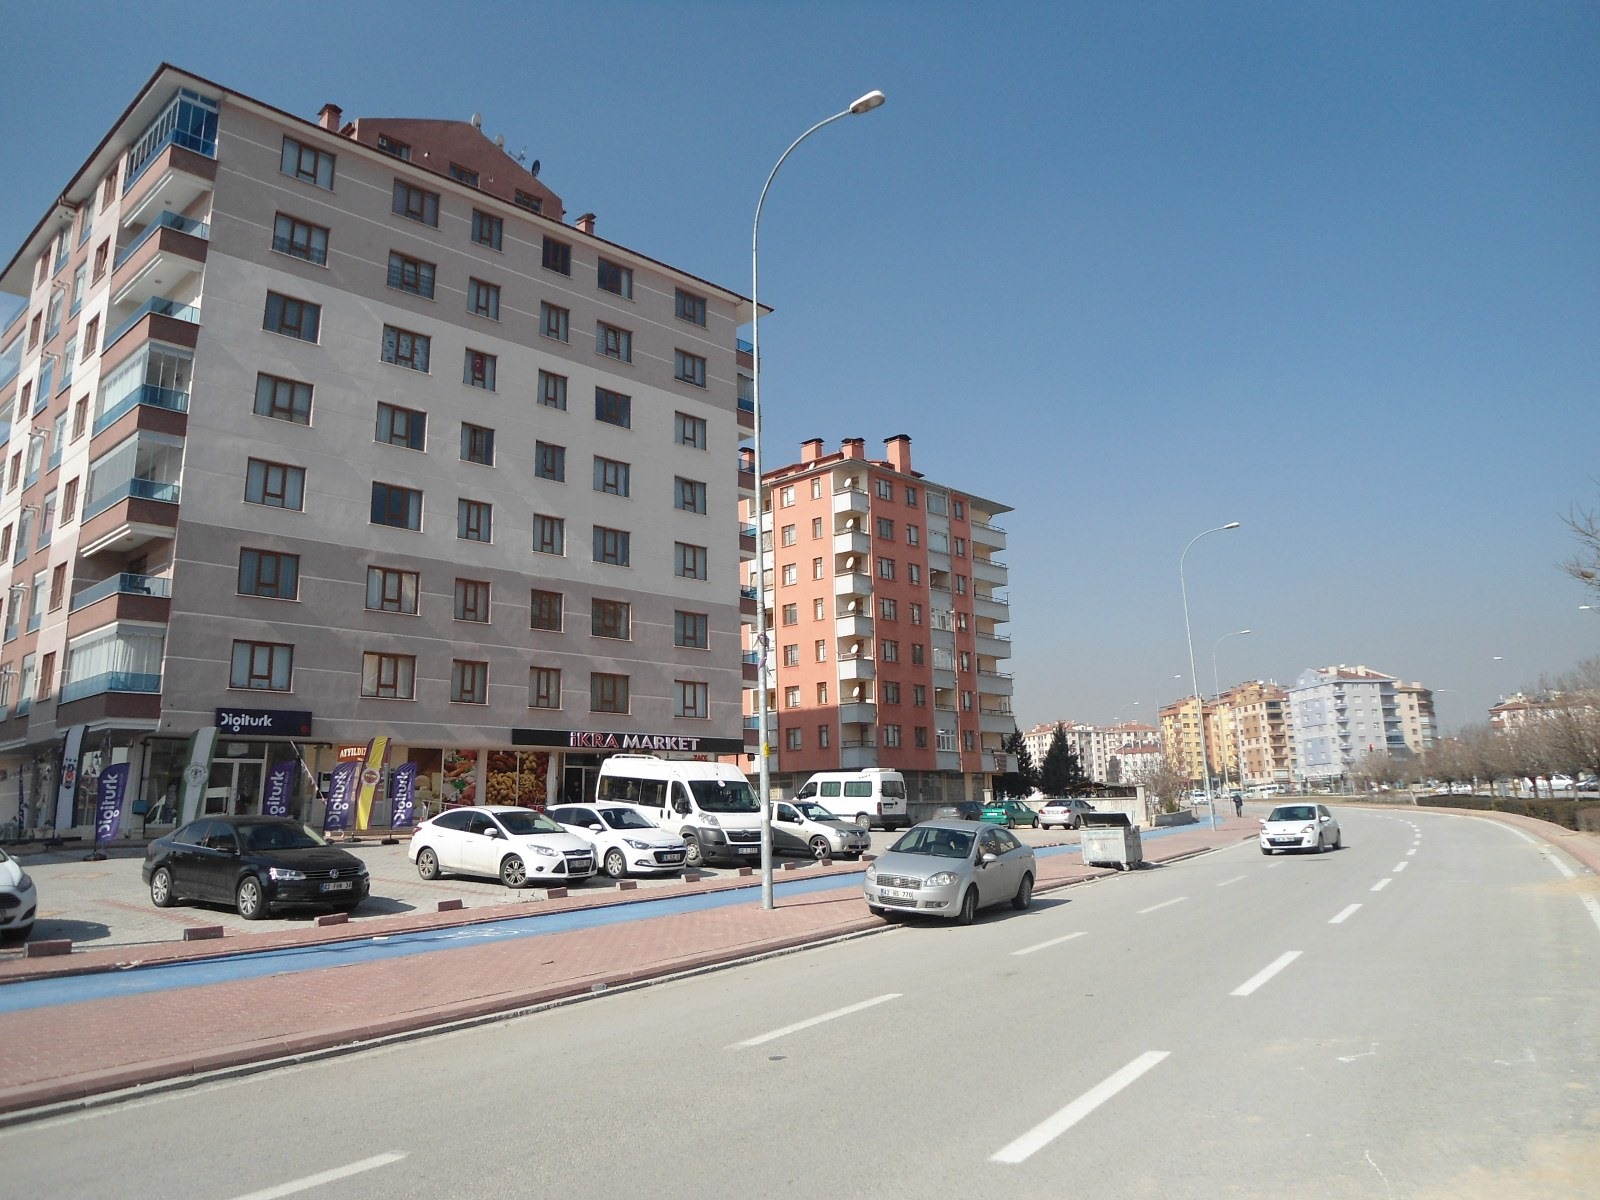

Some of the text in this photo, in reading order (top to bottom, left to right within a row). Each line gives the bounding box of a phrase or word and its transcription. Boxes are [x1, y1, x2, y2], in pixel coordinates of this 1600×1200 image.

[220, 712, 273, 732] Digiturk
[622, 734, 700, 751] MARKET
[98, 773, 120, 833] Digiturk
[266, 771, 286, 816] giturk
[328, 771, 349, 822] Digiturk
[394, 771, 413, 821] Digiturk
